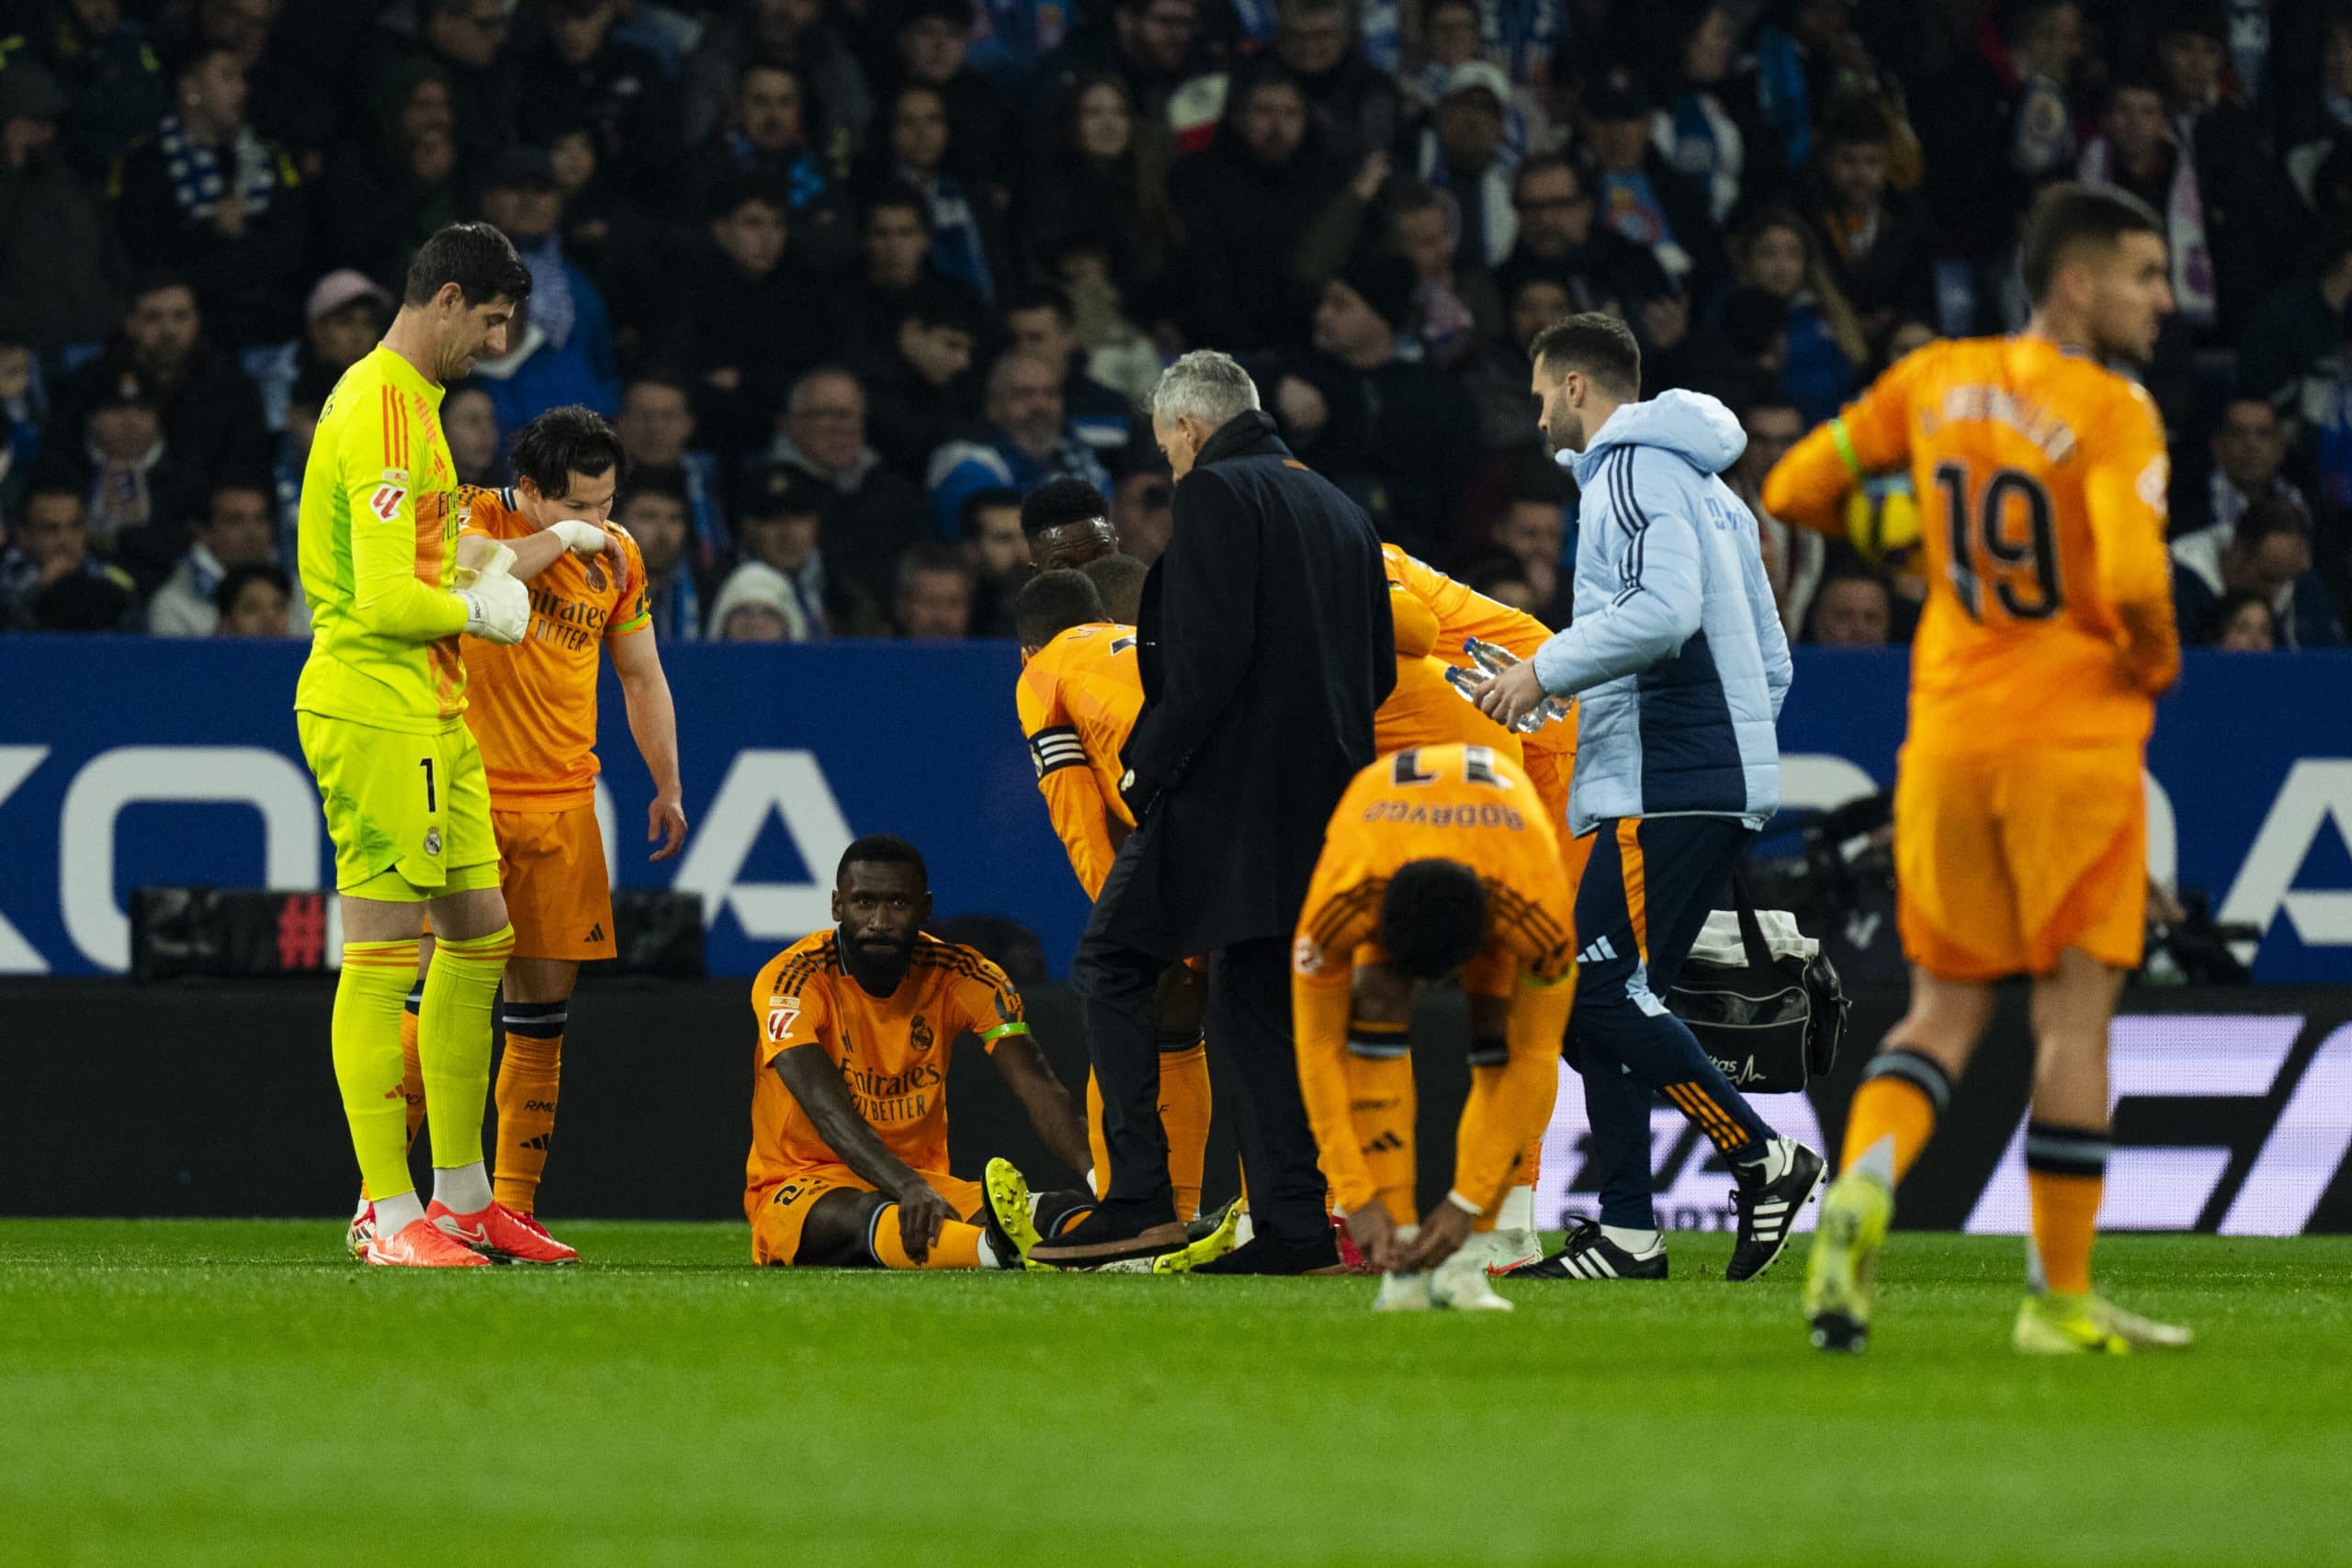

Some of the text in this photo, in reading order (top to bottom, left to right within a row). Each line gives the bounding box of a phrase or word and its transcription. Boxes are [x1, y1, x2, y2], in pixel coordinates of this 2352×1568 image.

[1933, 458, 2064, 622] 19
[419, 758, 437, 814] 1
[1391, 747, 1515, 791] 11
[1363, 800, 1526, 831] RODRYGO
[870, 1094, 928, 1122] BETTER
